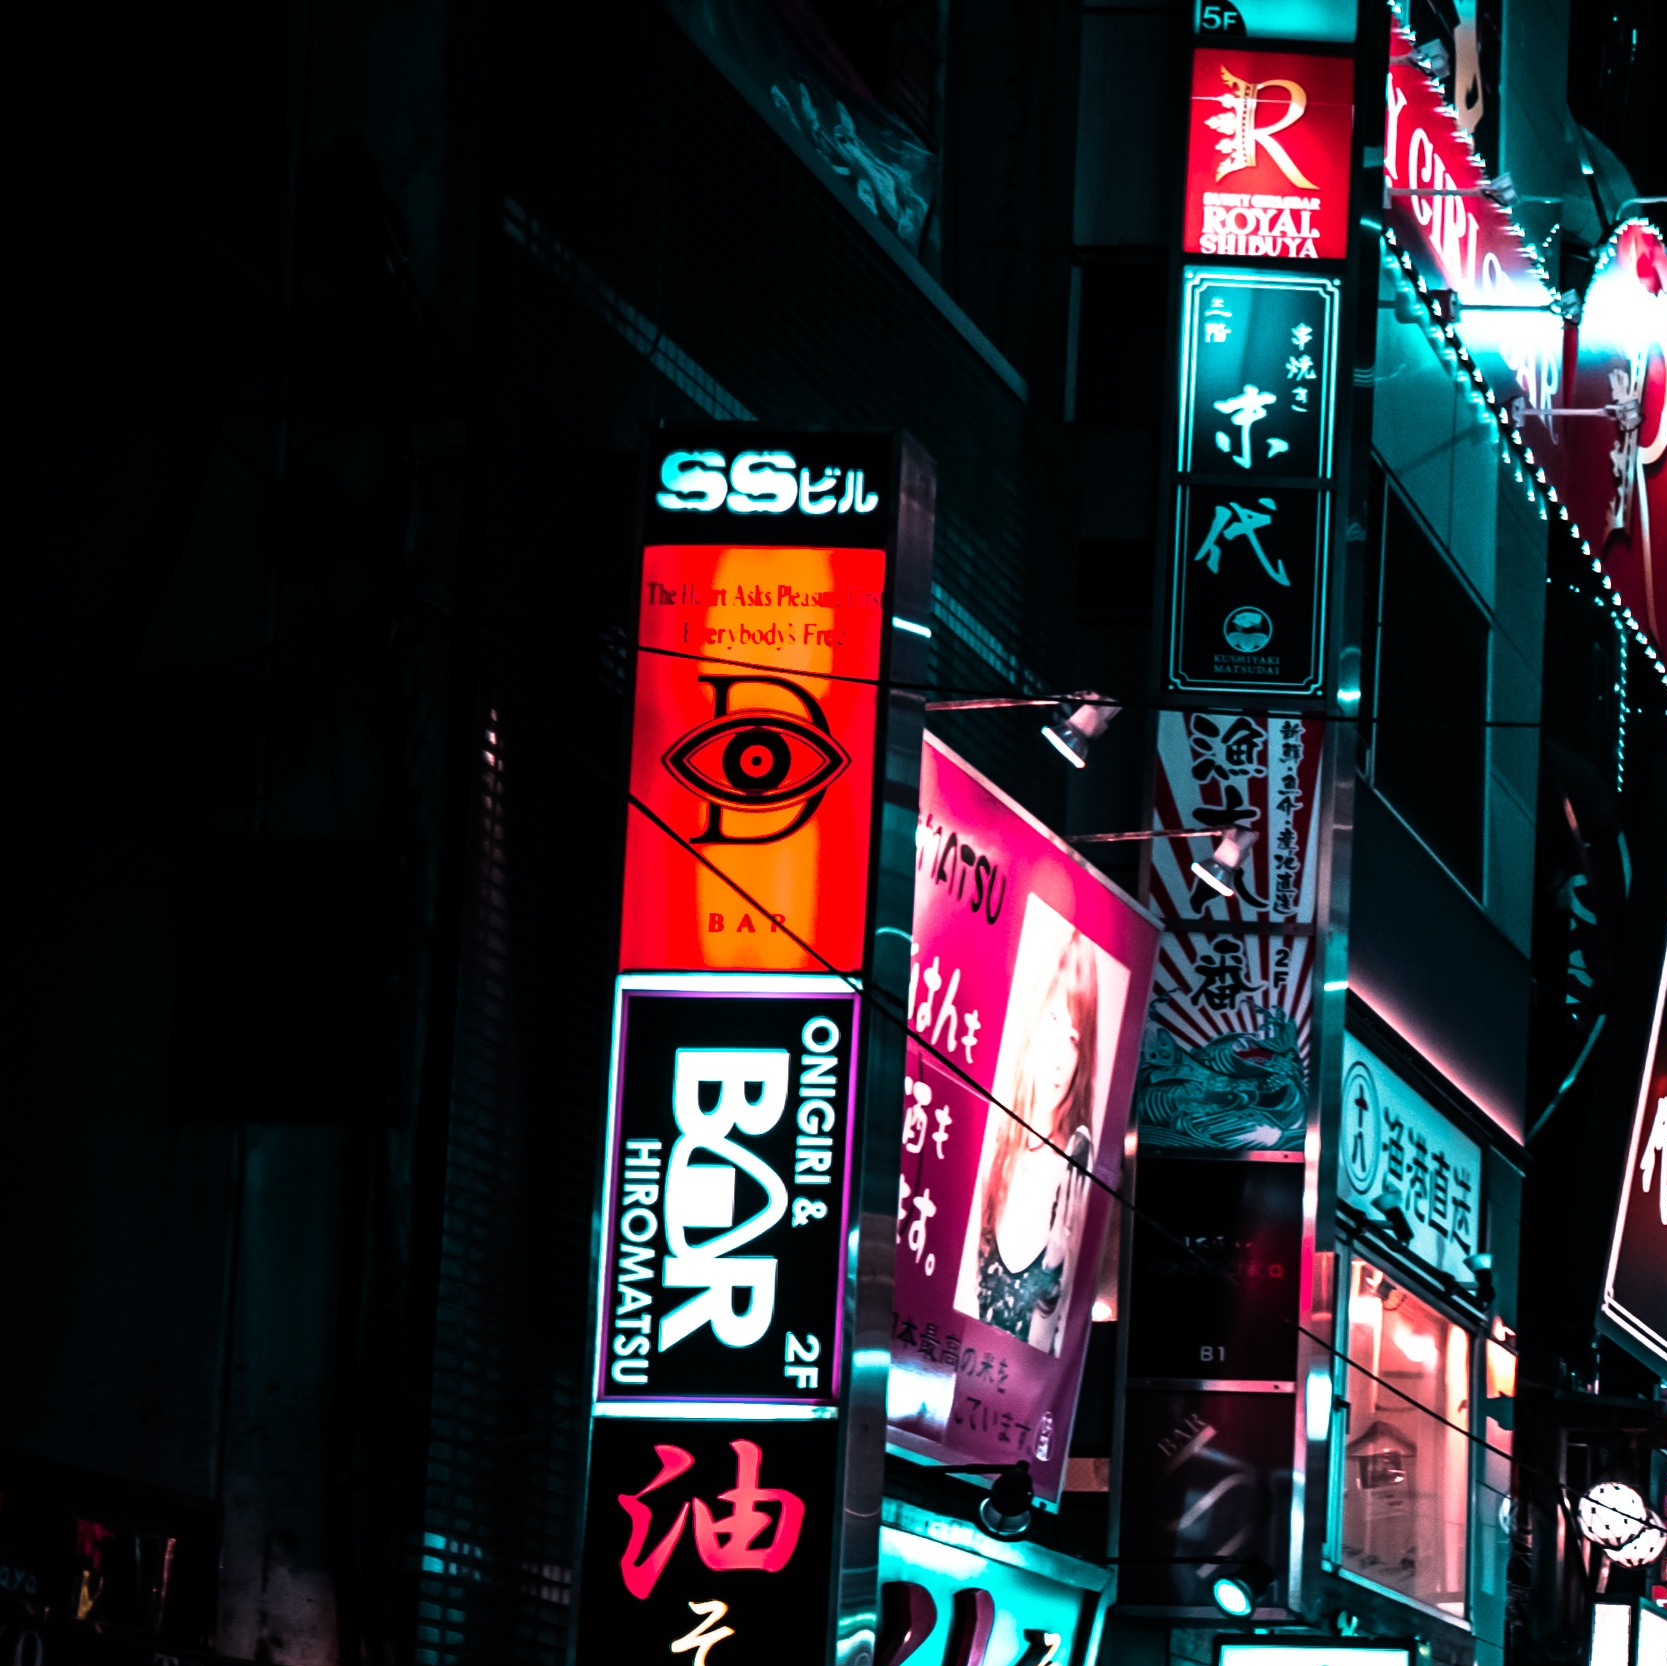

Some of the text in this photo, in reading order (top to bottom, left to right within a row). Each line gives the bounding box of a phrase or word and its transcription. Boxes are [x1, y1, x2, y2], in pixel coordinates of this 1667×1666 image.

[1202, 6, 1239, 30] 5F
[1202, 206, 1320, 238] ROYAL
[1200, 233, 1319, 259] SHIBUYA
[655, 450, 880, 515] SSビル
[648, 582, 677, 606] The
[732, 584, 773, 607] Asks
[1213, 654, 1280, 666] KUSHIYAKI
[1213, 664, 1280, 675] MATSUDAI
[707, 911, 788, 934] BAR
[1273, 948, 1290, 989] 2F
[792, 1016, 841, 1228] ONIGIRI &
[659, 1047, 791, 1353] BAR
[611, 1138, 662, 1386] HIROMATSU
[784, 1330, 821, 1390] 2F
